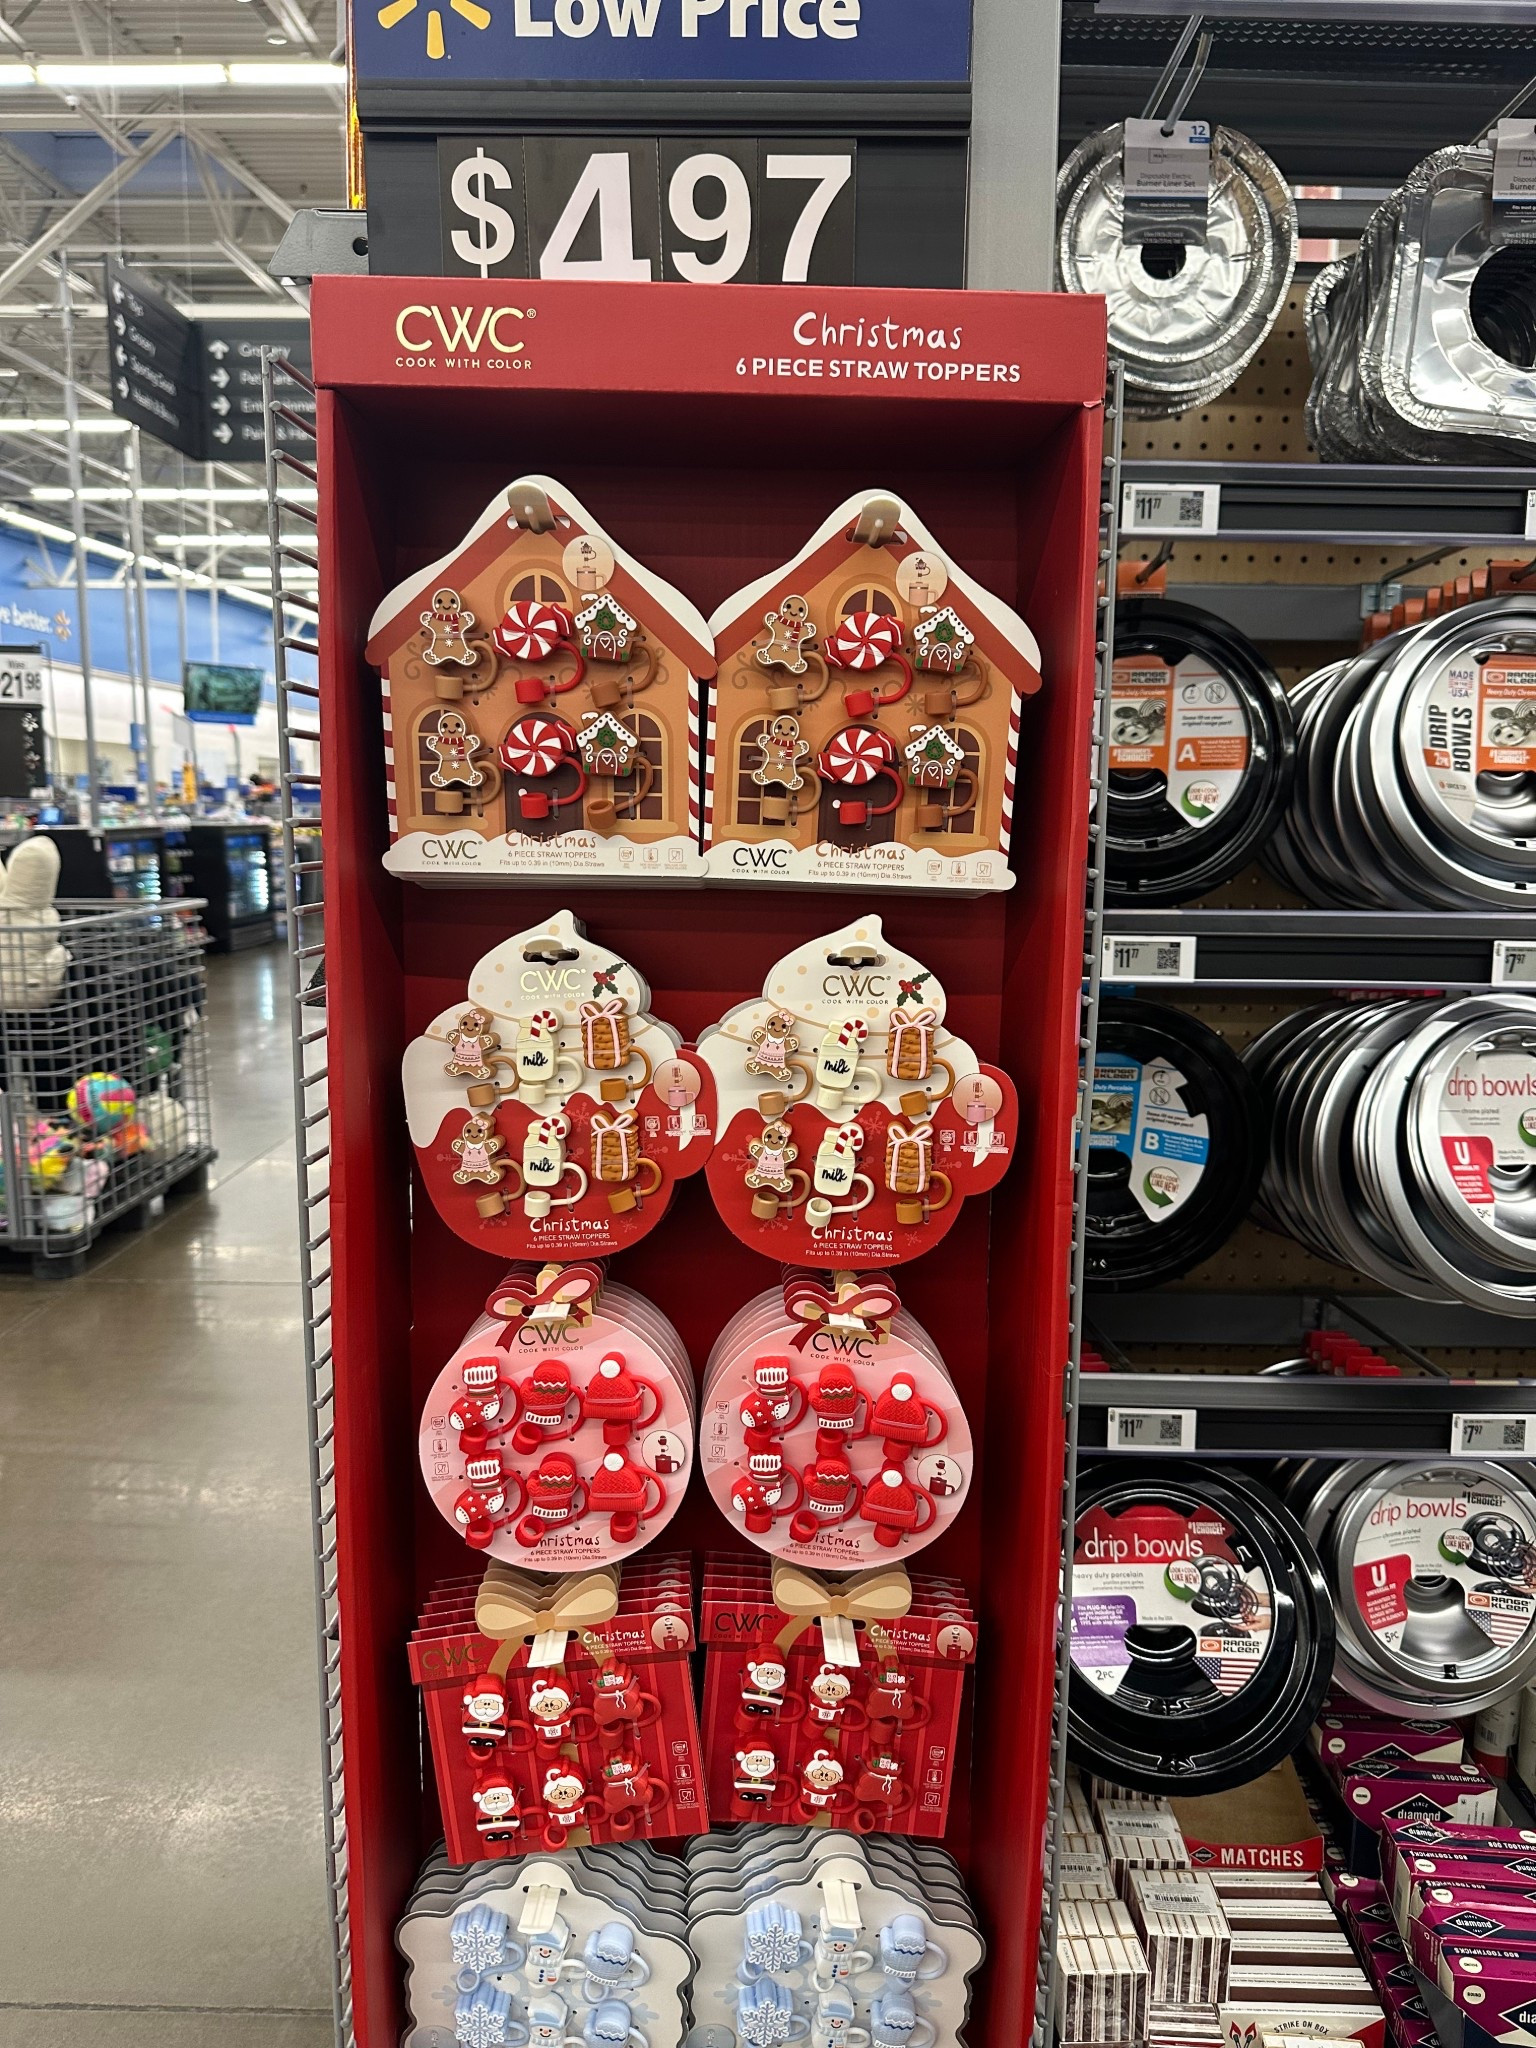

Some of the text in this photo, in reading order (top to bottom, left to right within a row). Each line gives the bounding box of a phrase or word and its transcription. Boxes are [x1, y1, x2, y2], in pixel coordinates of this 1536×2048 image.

[514, 0, 861, 39] Low Price
[1191, 126, 1205, 135] 12
[793, 312, 962, 349] Christmas
[396, 358, 532, 369] COOK WITH COLOR
[736, 358, 1020, 382] 6 PIECE STRAW TOPPERS
[1449, 670, 1473, 680] MADE
[1451, 689, 1468, 697] USA
[1429, 704, 1447, 749] DRIP
[1452, 707, 1472, 772] BOWLS
[1178, 744, 1196, 762] A
[505, 829, 597, 849] Christmas
[815, 840, 906, 861] Christmas
[871, 863, 905, 871] TOPPERS
[523, 1051, 548, 1067] milk
[823, 1058, 850, 1074] milk
[1448, 1066, 1477, 1101] drip
[1145, 1132, 1159, 1150] B
[1454, 1142, 1470, 1165] U
[530, 1157, 555, 1173] milk
[821, 1167, 848, 1182] milk
[529, 1217, 610, 1232] Christmas
[581, 1232, 610, 1240] TOPPERS
[811, 1225, 893, 1242] Christmas
[1370, 1497, 1467, 1526] drip bowls
[812, 1544, 832, 1552] STRAW
[834, 1546, 859, 1556] TOPPERS
[1084, 1527, 1204, 1563] drip bowls
[1458, 1542, 1472, 1550] NEW!
[1111, 1571, 1144, 1579] porcelain
[1184, 1575, 1199, 1584] NEW!
[1371, 1563, 1387, 1587] U
[1492, 1596, 1529, 1606] RANGE
[583, 1629, 645, 1643] Christmas
[870, 1625, 931, 1641] Christmas
[1398, 1809, 1440, 1821] diamond
[1221, 1848, 1303, 1867] MATCHES
[1456, 1919, 1492, 1928] diamond
[1274, 2020, 1300, 2034] STRIKE
[1315, 2024, 1329, 2035] BOX
